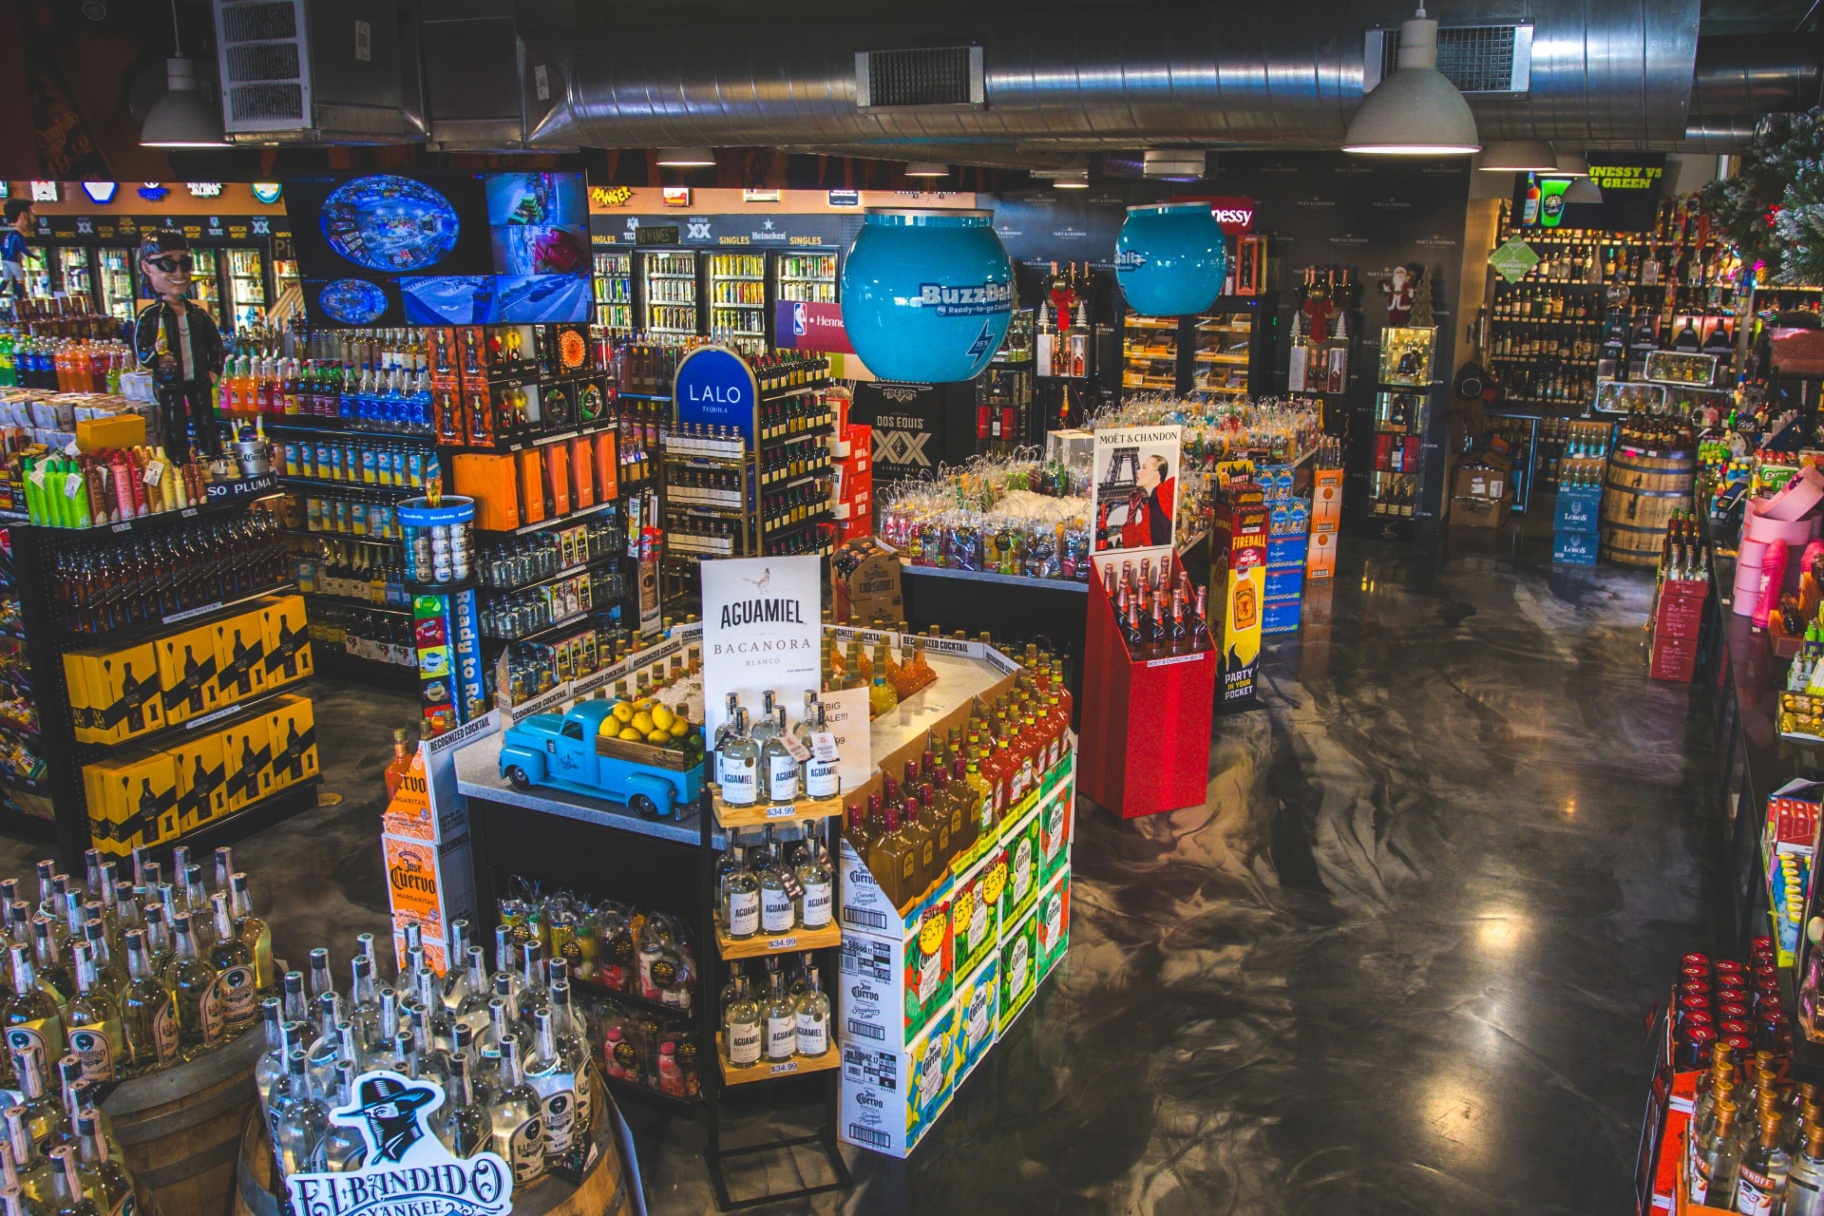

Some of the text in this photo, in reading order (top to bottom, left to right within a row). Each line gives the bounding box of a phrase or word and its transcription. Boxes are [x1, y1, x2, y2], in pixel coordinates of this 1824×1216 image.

[1589, 166, 1643, 178] NNESSY
[1602, 178, 1651, 189] GREEN
[591, 186, 632, 205] RANGER
[1211, 209, 1252, 226] nessy
[252, 220, 270, 234] XX
[687, 223, 711, 239] XX
[592, 235, 615, 243] INGLES
[719, 236, 750, 245] SINGLES
[752, 231, 786, 240] Heineken
[790, 236, 822, 245] SINGLES
[922, 280, 1014, 305] BuzzBall
[948, 303, 994, 315] Ready-to-go
[817, 315, 845, 328] Henne
[690, 384, 741, 404] LALO
[702, 405, 728, 414] TEQUILA
[877, 415, 924, 429] DOS EQUIS
[1737, 420, 1756, 430] Party
[1099, 431, 1178, 445] MOËT & CHANDON
[872, 429, 932, 467] XX
[1230, 474, 1250, 484] PARTY
[1764, 471, 1789, 480] Extra
[234, 478, 272, 494] PLUMA
[1232, 534, 1266, 551] FIREBALL
[720, 598, 804, 629] AGUAMIEL
[456, 591, 475, 654] Ready
[714, 638, 811, 655] BACANORA
[940, 639, 969, 653] COCKTAIL
[633, 640, 680, 667] RECOGNIZED COCKTAIL
[462, 658, 476, 679] to
[746, 658, 780, 666] BLANCO
[573, 665, 627, 694] RECOGNIZED COCKTAIL
[1224, 668, 1253, 684] PARTY
[1227, 678, 1251, 690] IN YOUR
[1225, 685, 1253, 700] POCKET
[512, 690, 567, 720] ECOGNIZED COCKTAIL
[825, 702, 841, 712] BIG
[825, 713, 848, 723] ALE!!!
[430, 717, 491, 752] RECOGNIZED COCKTAIL
[724, 773, 753, 784] AGUAMIEL
[766, 807, 795, 816] $34.99
[404, 859, 422, 874] Jose
[390, 865, 436, 895] Cuervo
[984, 870, 1005, 895] $5.99
[396, 892, 435, 906] MARGARITAS
[921, 917, 945, 941] $5.99
[769, 938, 796, 947] $34.99
[851, 985, 879, 1002] Cuervo
[859, 982, 872, 991] Jose
[733, 1034, 761, 1047] AGUAMIEL
[770, 1063, 797, 1073] $34.99
[922, 1047, 942, 1077] Cuervo
[856, 1092, 883, 1109] Cuervo
[865, 1090, 876, 1098] Jose
[346, 1159, 504, 1208] BANDIDO
[1742, 1166, 1775, 1188] IRNOFF
